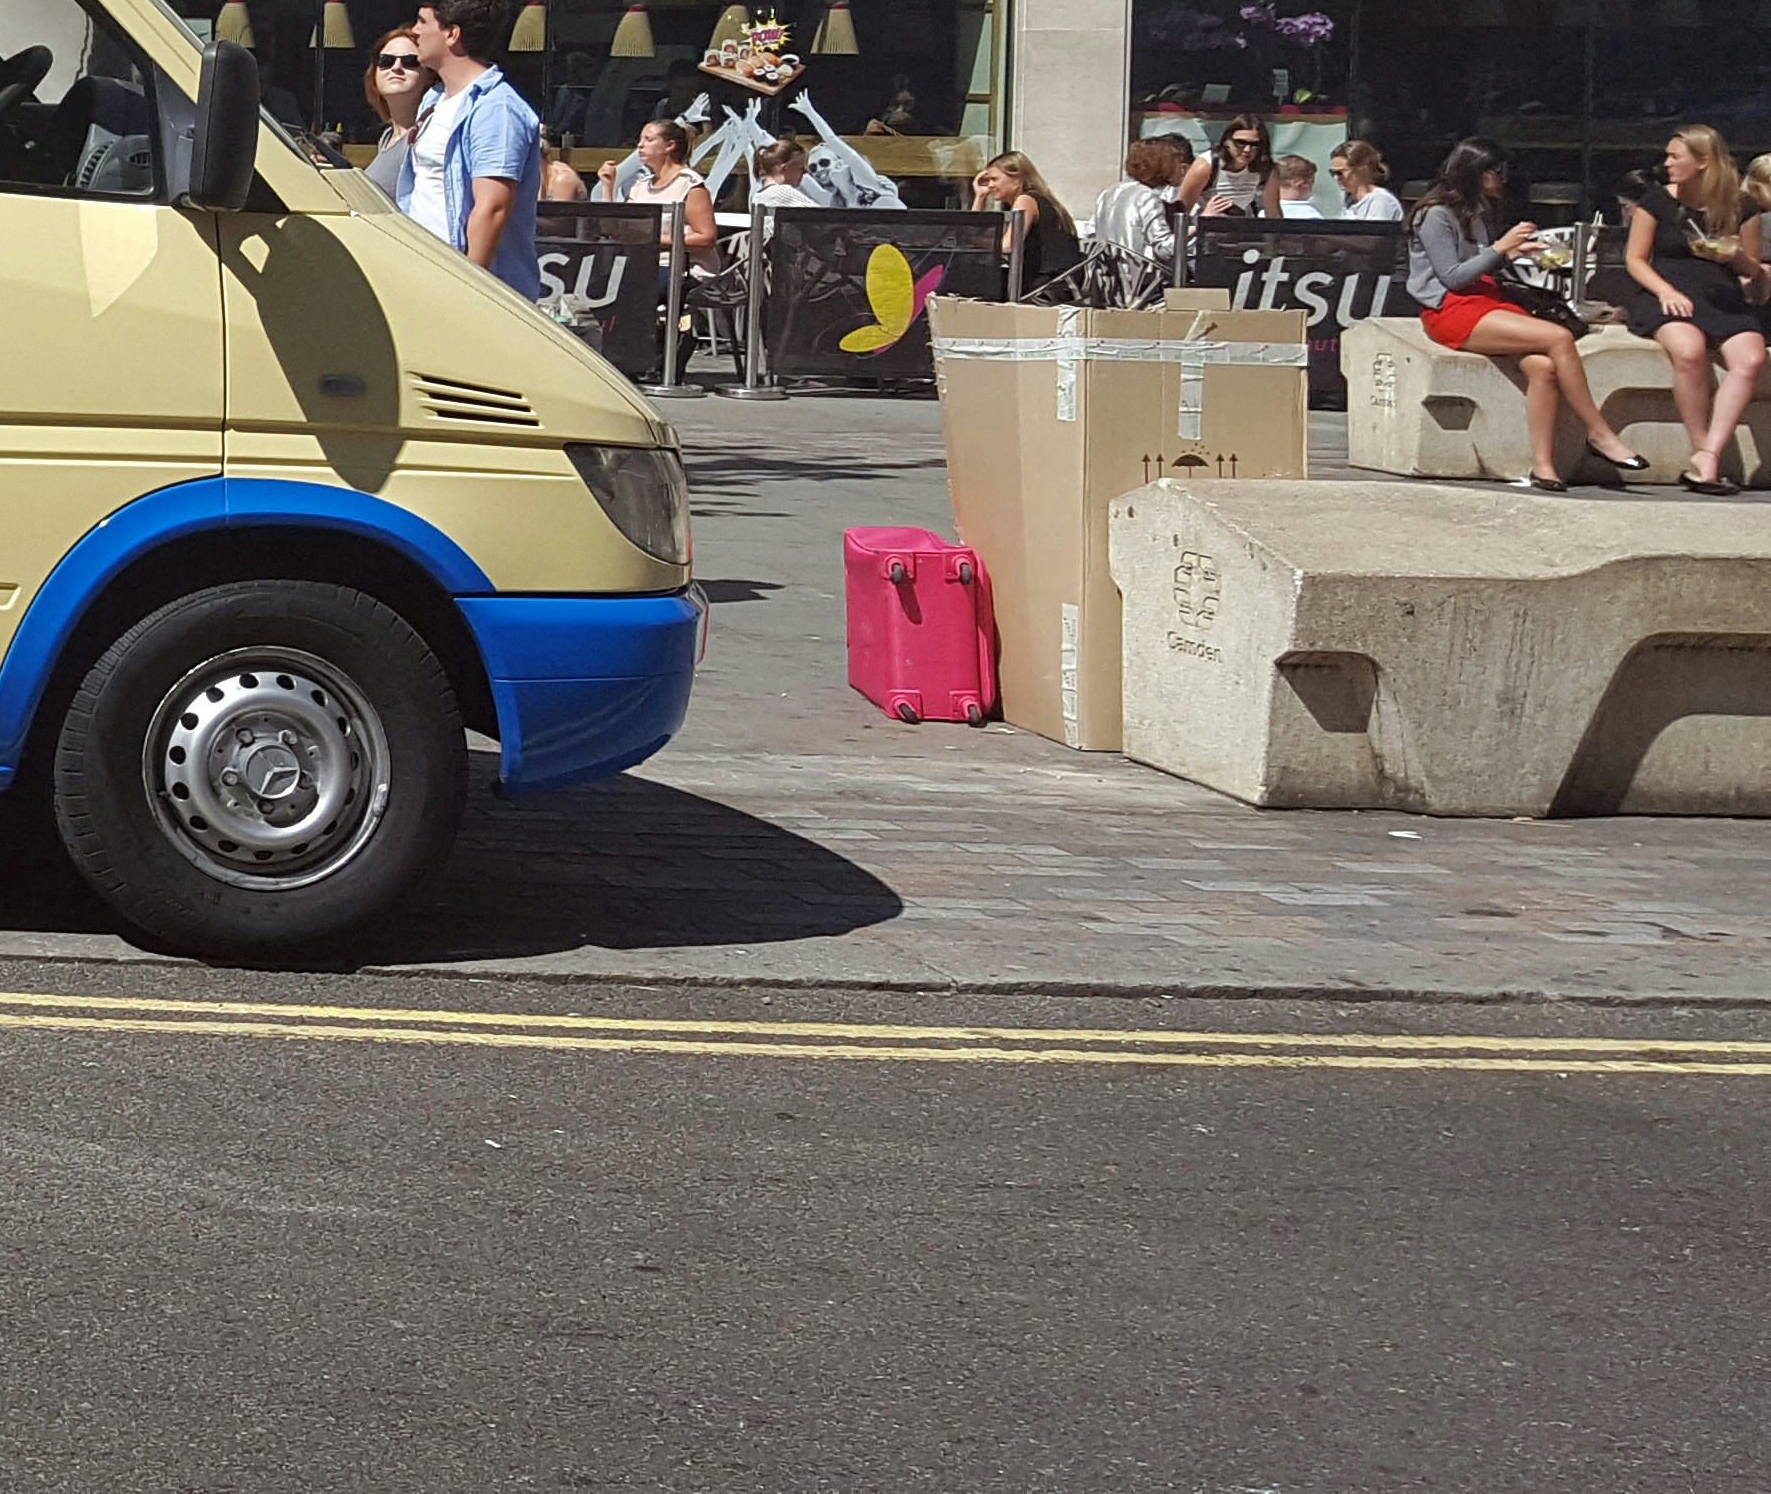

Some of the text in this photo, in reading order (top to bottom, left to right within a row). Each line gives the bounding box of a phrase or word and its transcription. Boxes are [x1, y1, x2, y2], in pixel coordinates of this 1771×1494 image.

[536, 252, 628, 309] su
[1231, 249, 1392, 329] itsu
[1166, 630, 1223, 664] Camden
